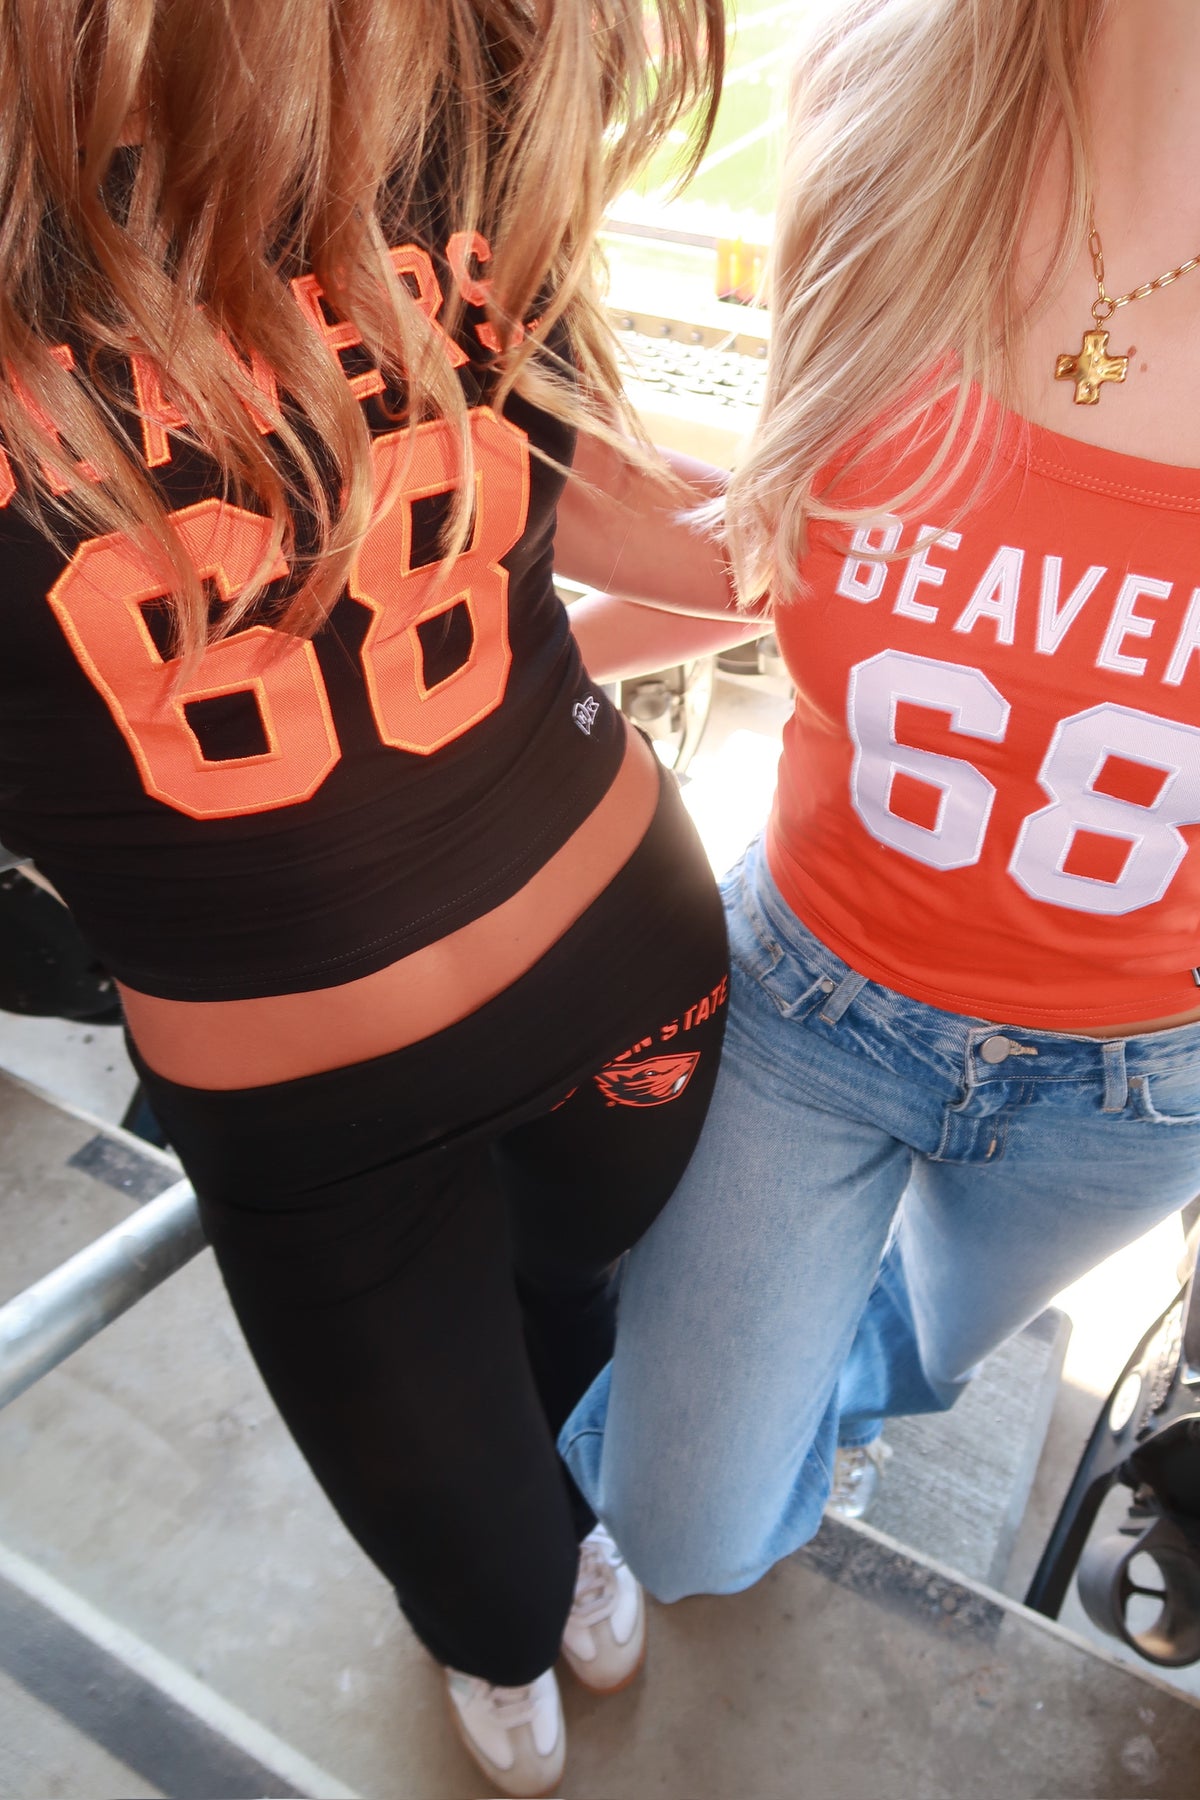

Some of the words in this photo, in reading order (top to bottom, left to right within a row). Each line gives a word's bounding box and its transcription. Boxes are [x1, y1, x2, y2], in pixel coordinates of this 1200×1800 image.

[46, 405, 530, 820] 68
[847, 648, 1200, 916] 68
[660, 974, 728, 1041] STATE
